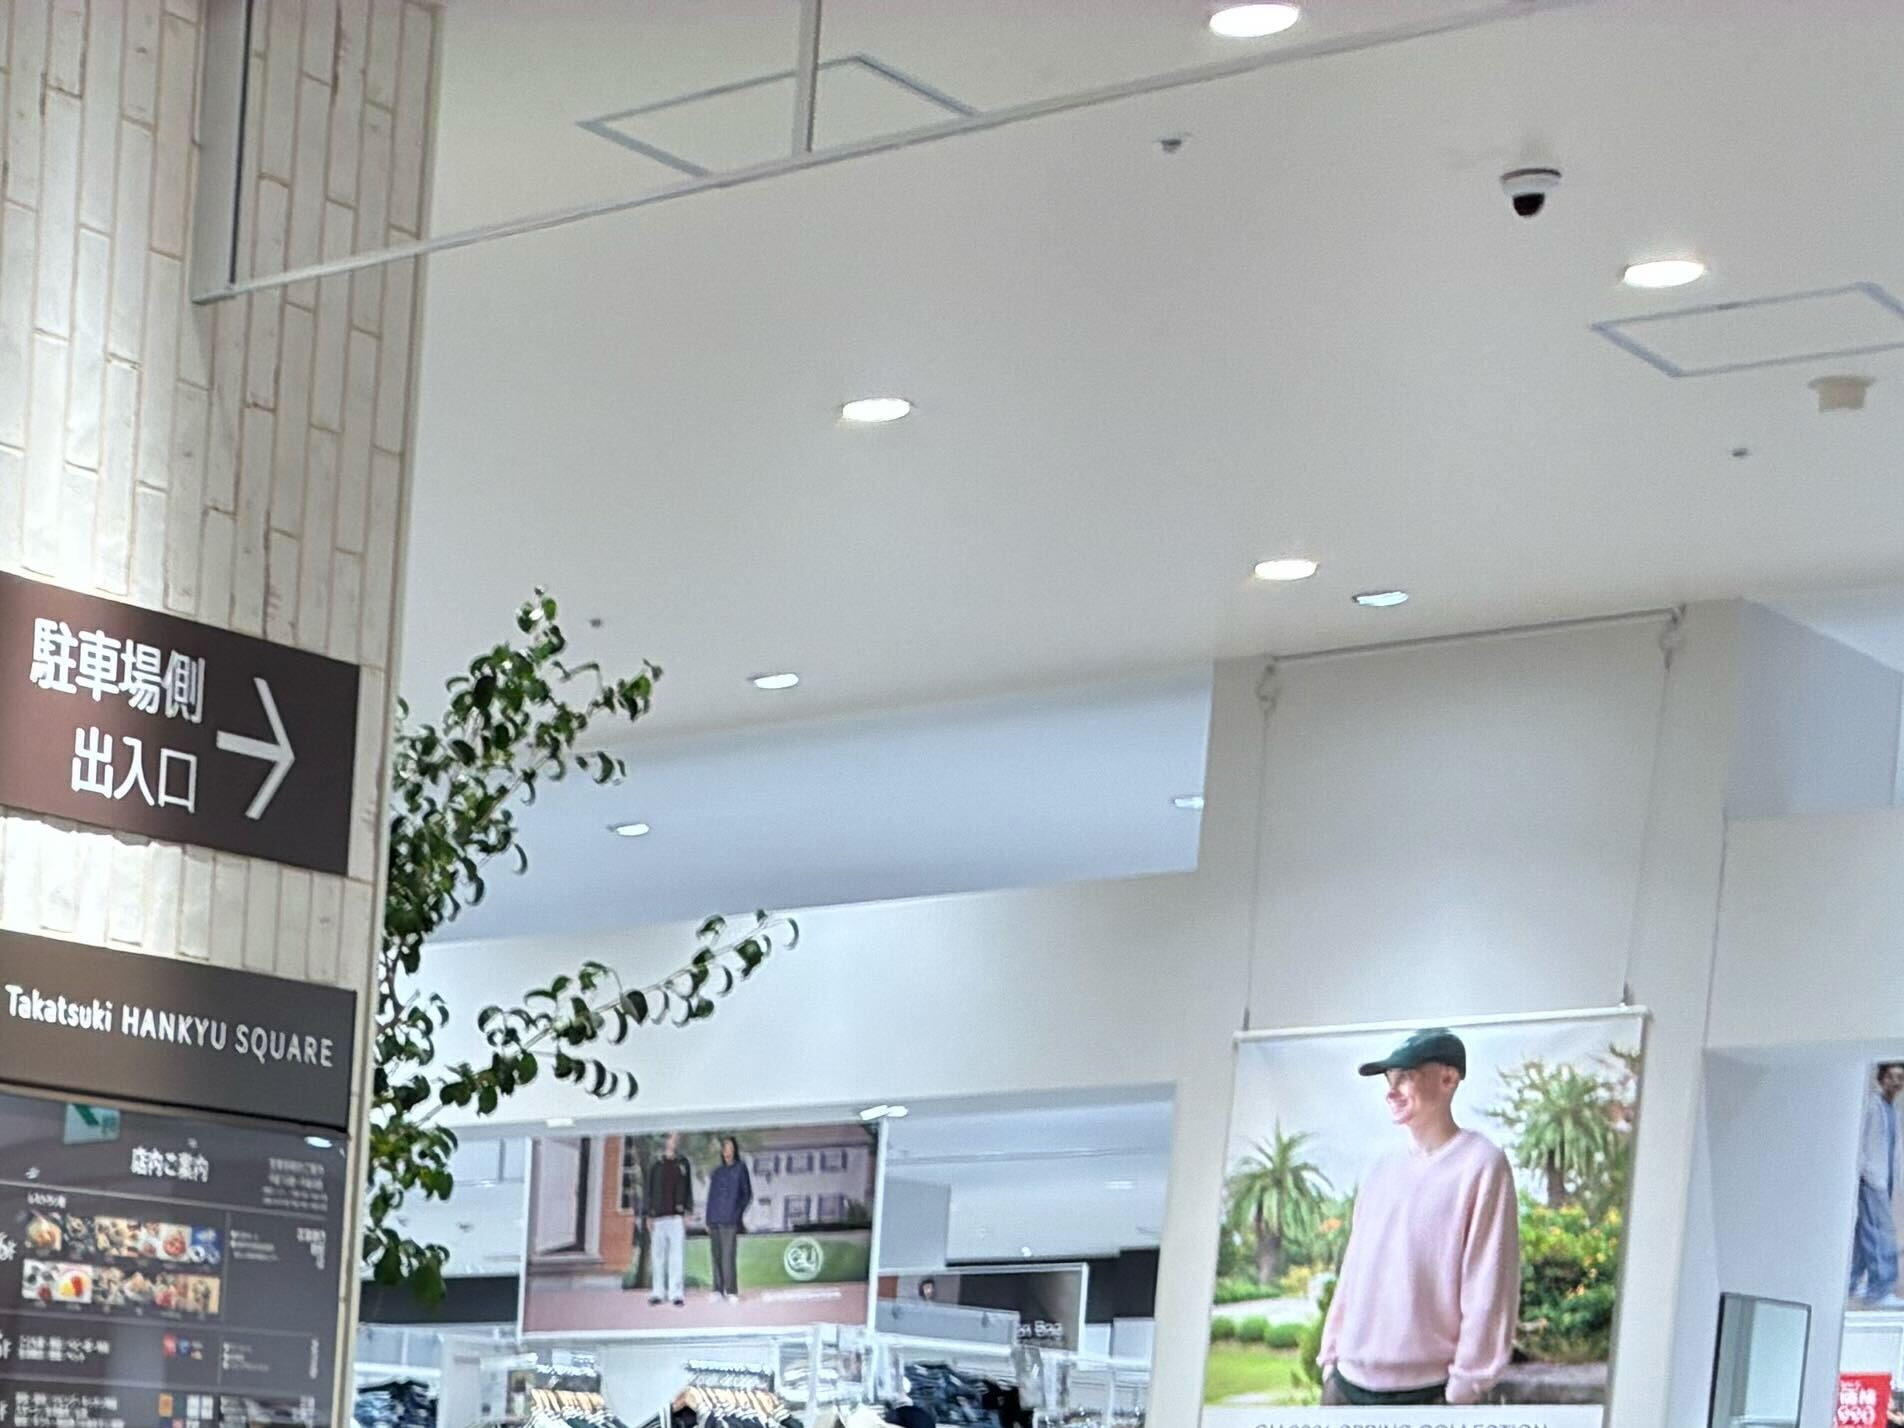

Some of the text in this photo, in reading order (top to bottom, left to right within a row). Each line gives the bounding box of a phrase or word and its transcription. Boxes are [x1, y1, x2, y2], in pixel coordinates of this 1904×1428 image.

[29, 617, 206, 723] 駐車場側
[71, 726, 197, 813] 出入口
[4, 984, 334, 1068] Takatsuki HANKYU SQUARE
